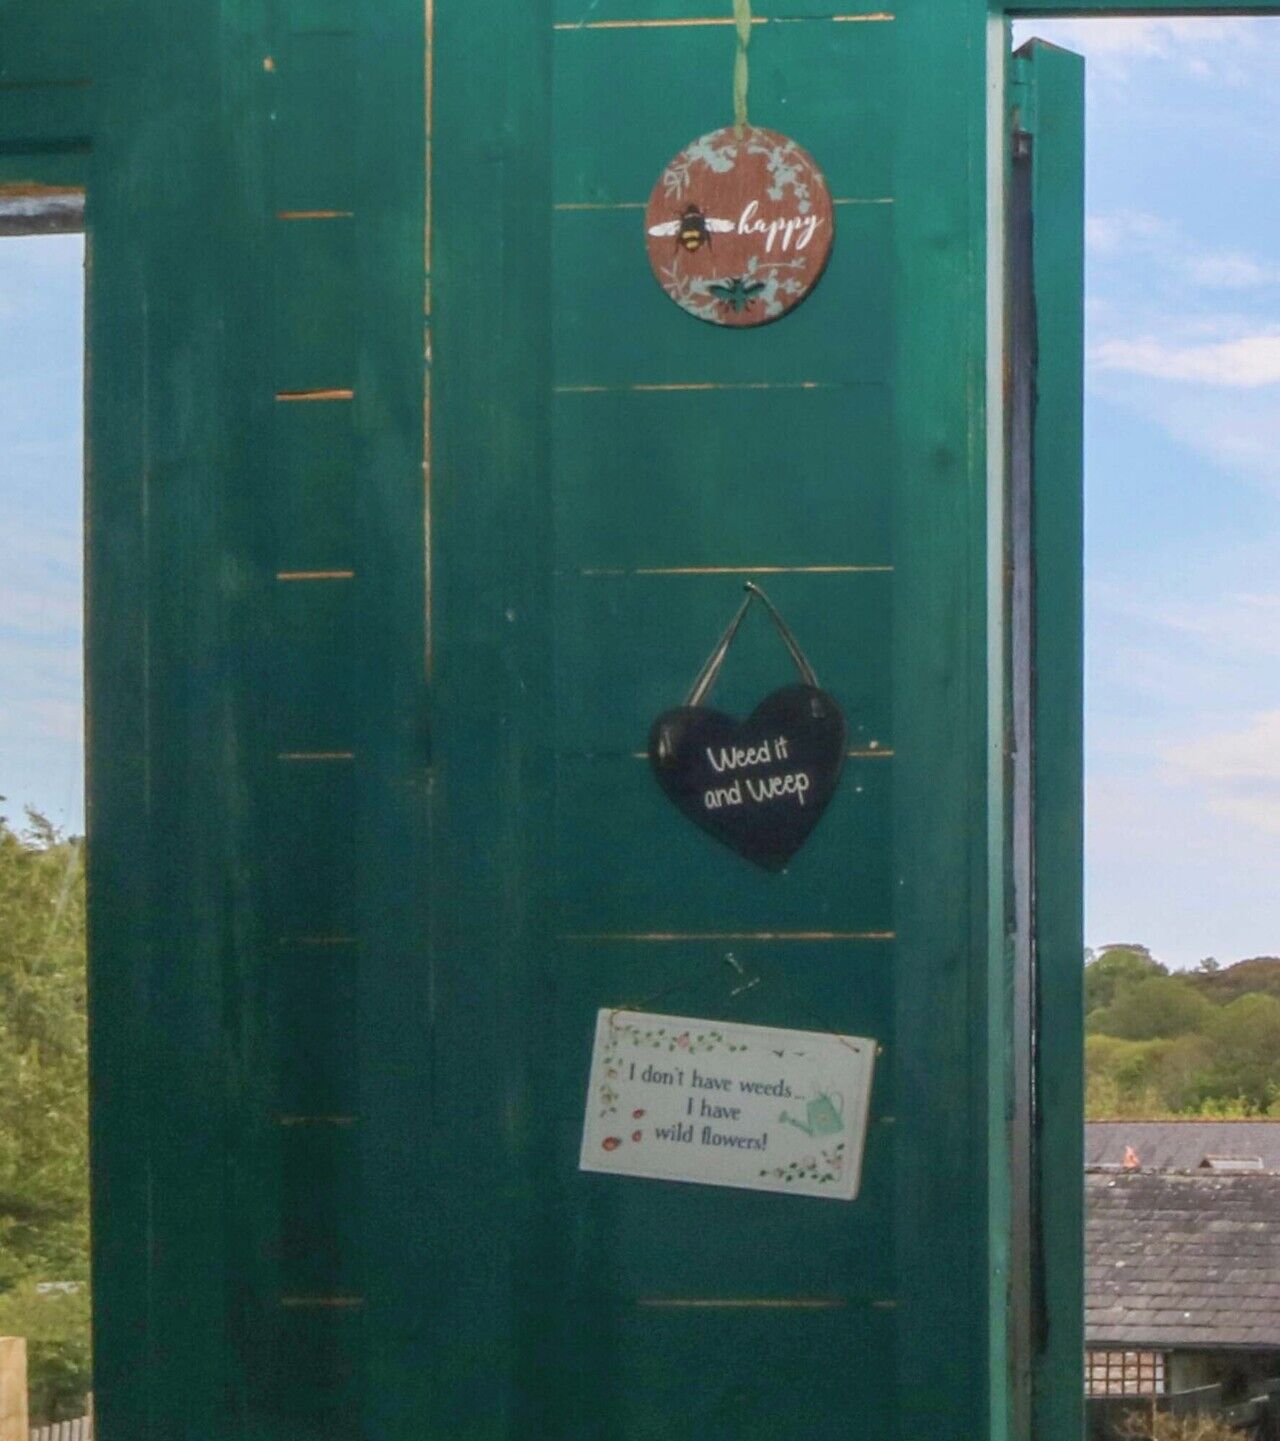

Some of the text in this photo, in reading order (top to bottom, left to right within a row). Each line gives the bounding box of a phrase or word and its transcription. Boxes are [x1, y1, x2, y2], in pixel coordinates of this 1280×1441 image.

[738, 201, 824, 252] happy
[706, 736, 788, 772] Weed it
[704, 780, 742, 809] and
[628, 1062, 636, 1081] I
[641, 1065, 684, 1086] don't
[692, 1069, 732, 1092] have
[686, 1097, 741, 1121] I have
[655, 1123, 767, 1151] wild flowers!
